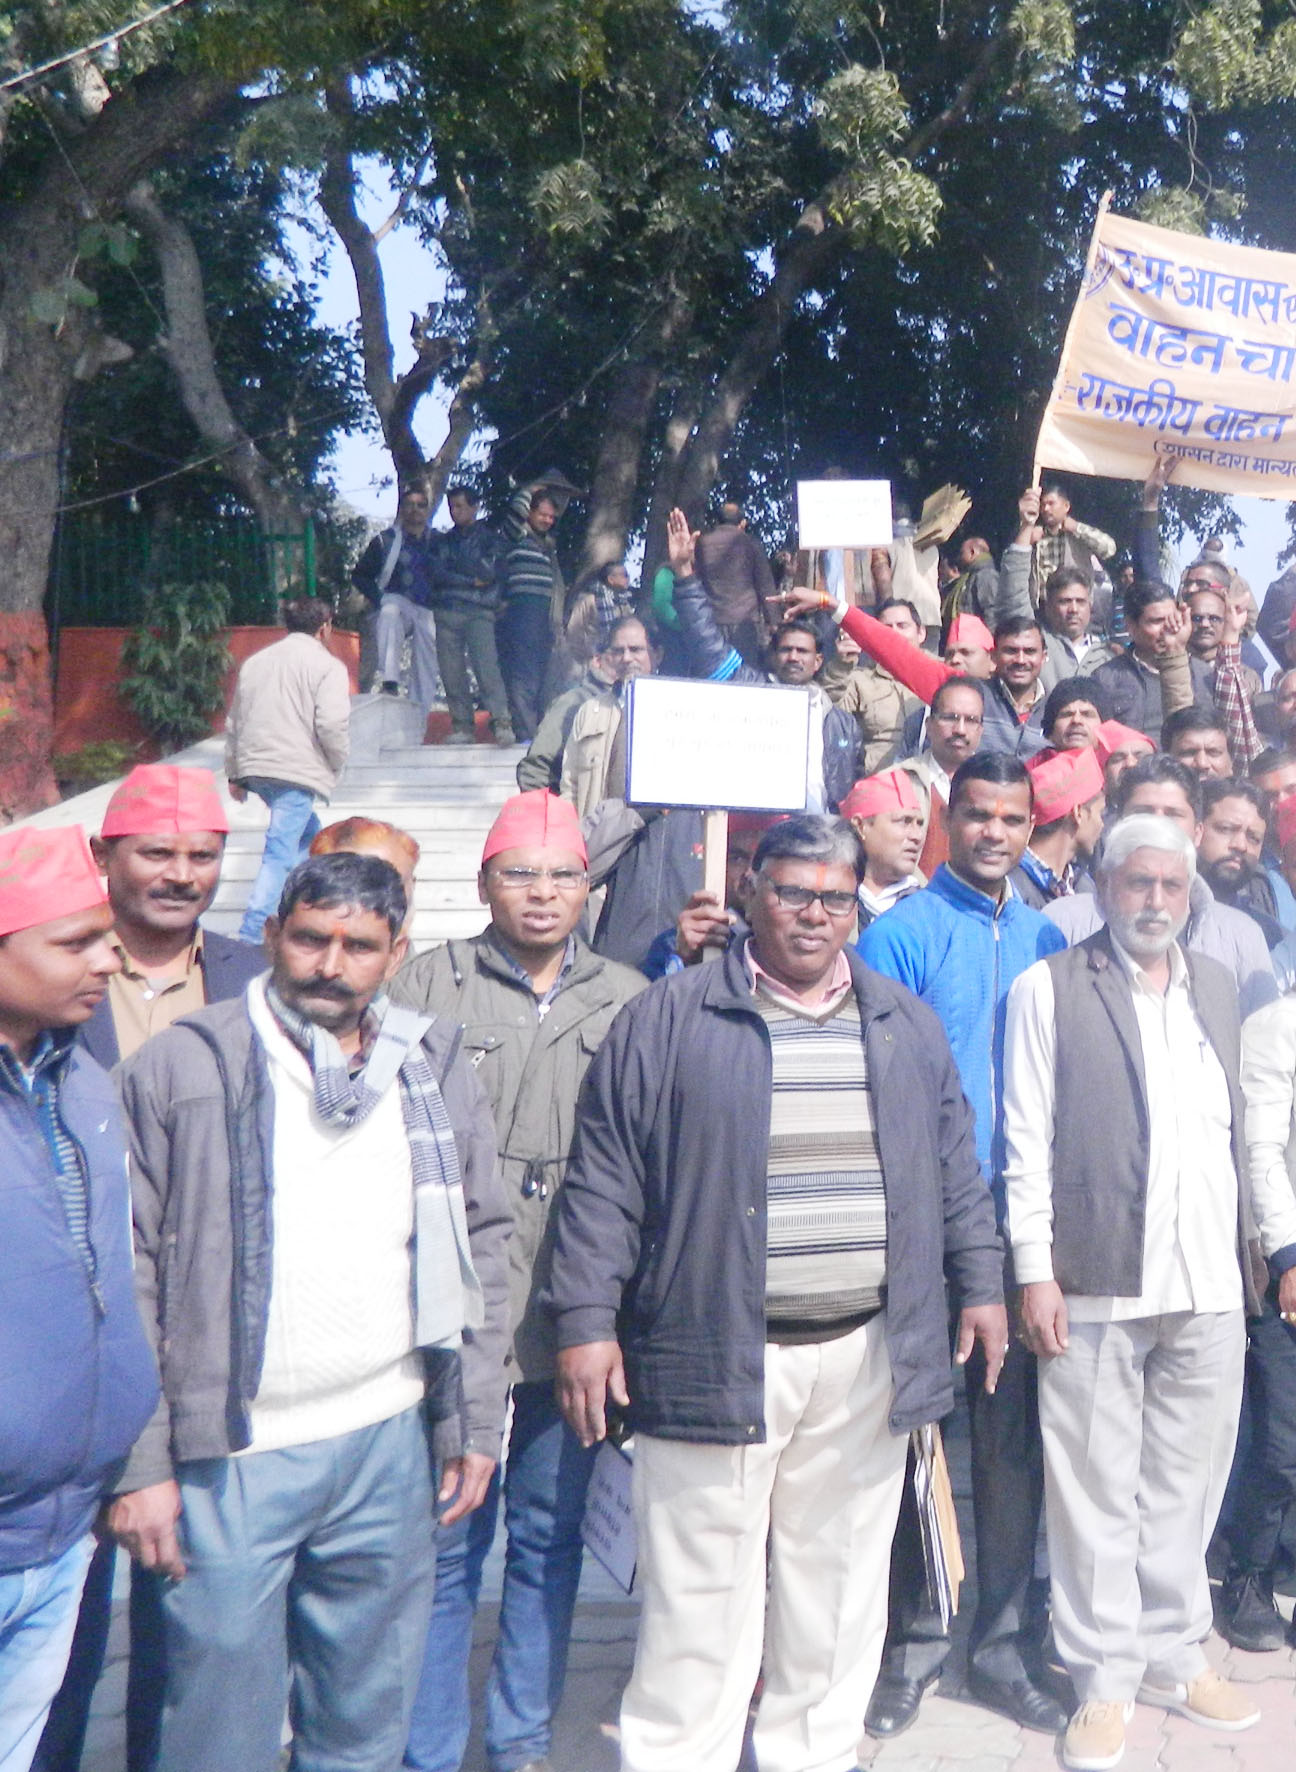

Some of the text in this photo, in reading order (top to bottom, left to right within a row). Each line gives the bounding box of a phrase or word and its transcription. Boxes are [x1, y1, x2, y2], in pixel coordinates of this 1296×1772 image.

[1173, 264, 1289, 325] आवास
[1107, 301, 1234, 375] वाहन
[1076, 371, 1204, 436] राजकीय
[1204, 403, 1294, 443] वाहन
